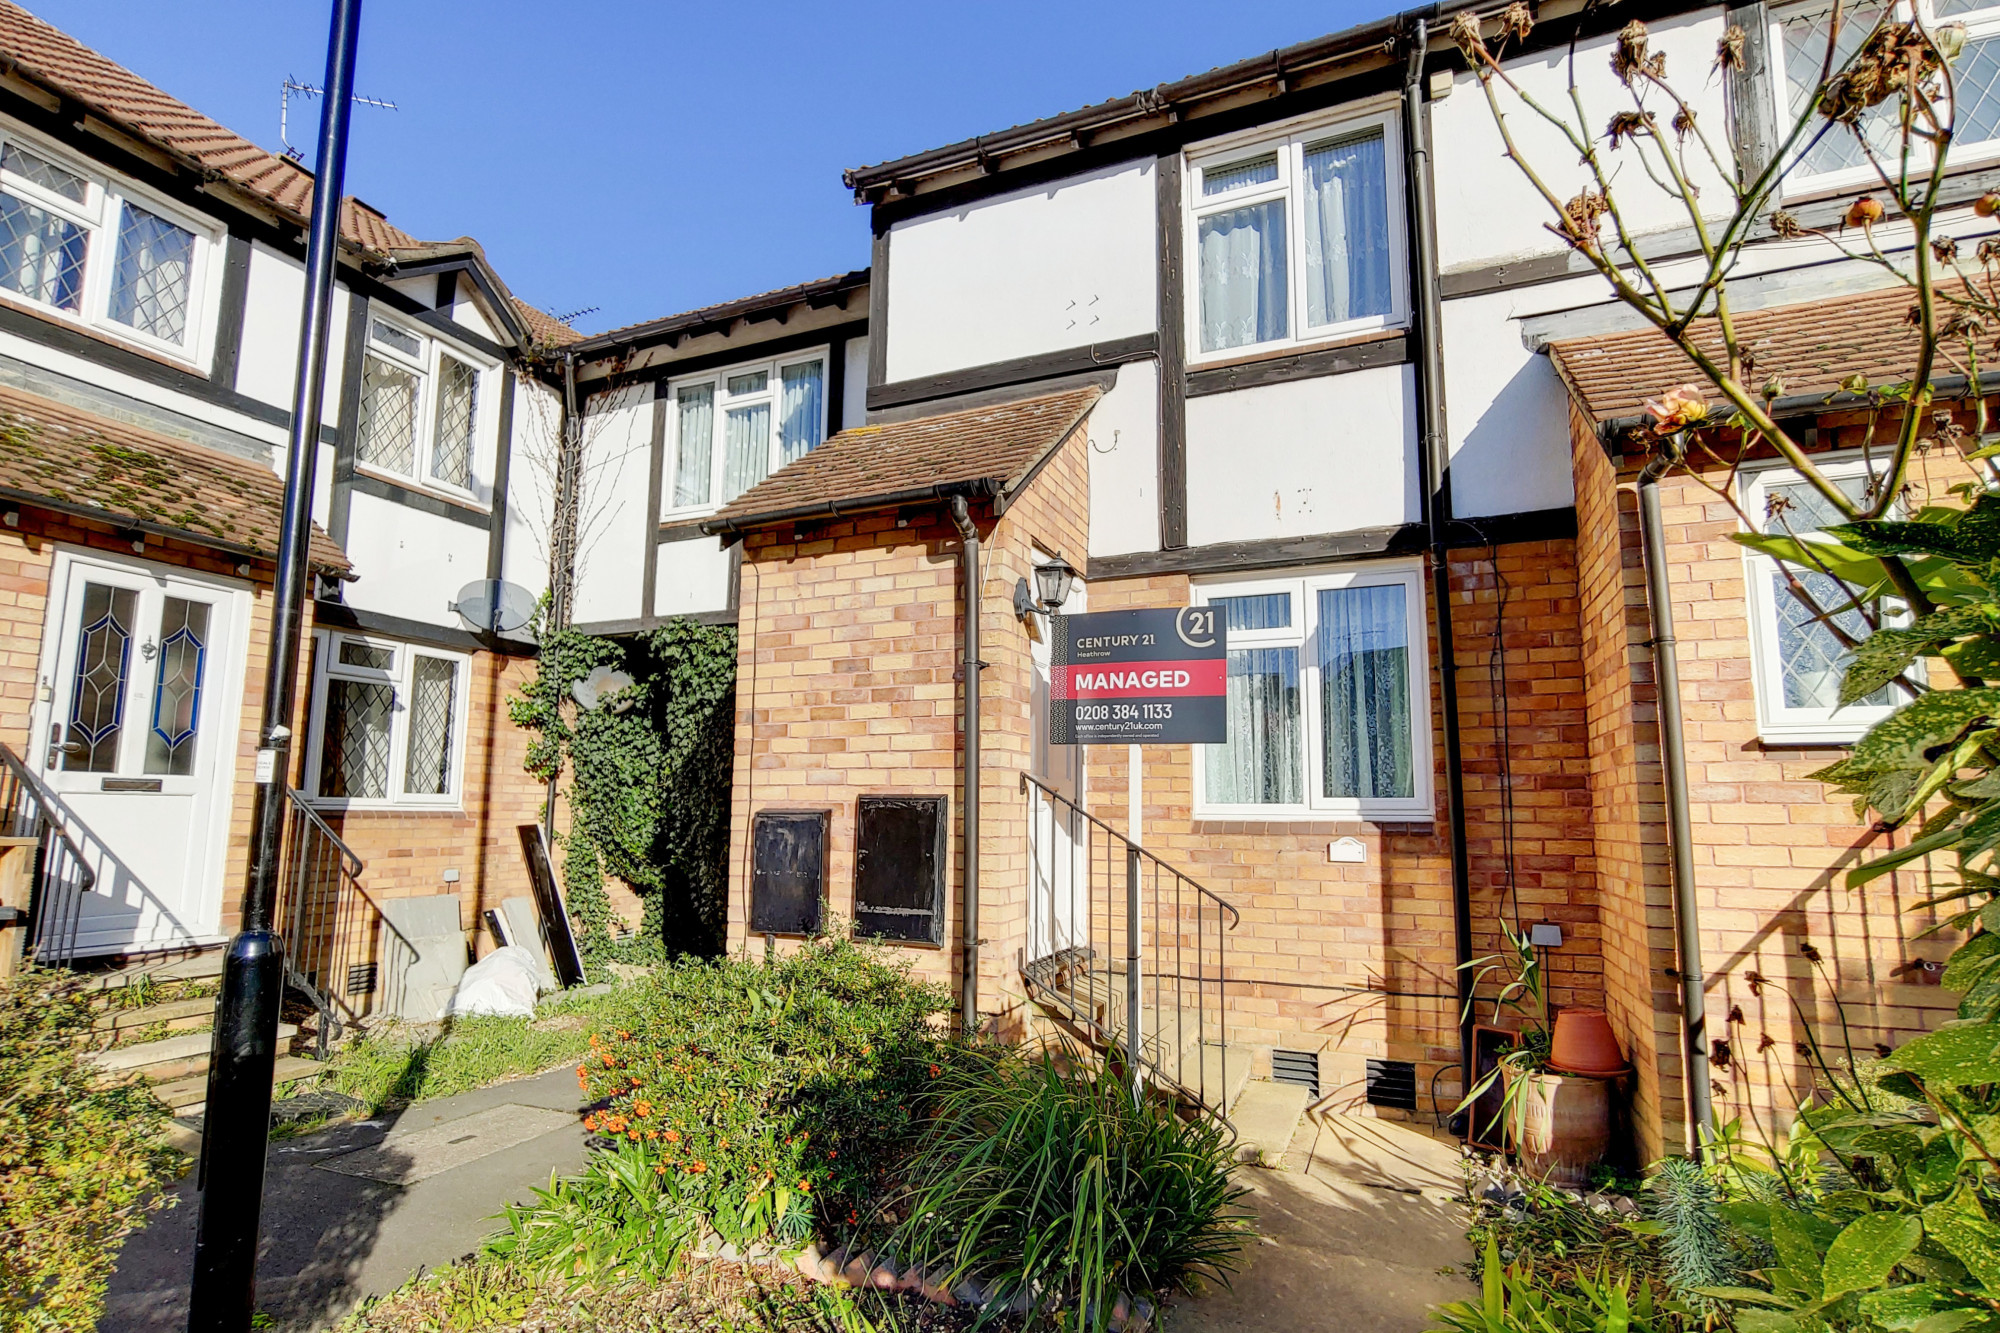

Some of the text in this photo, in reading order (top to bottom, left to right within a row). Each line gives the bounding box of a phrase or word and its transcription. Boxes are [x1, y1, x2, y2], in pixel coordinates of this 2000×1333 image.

[1076, 634, 1155, 649] CENTURY 21
[1075, 670, 1190, 690] MANAGED
[1075, 703, 1172, 720] 0208 384 1133
[1075, 722, 1163, 731] www.century21uk.com
